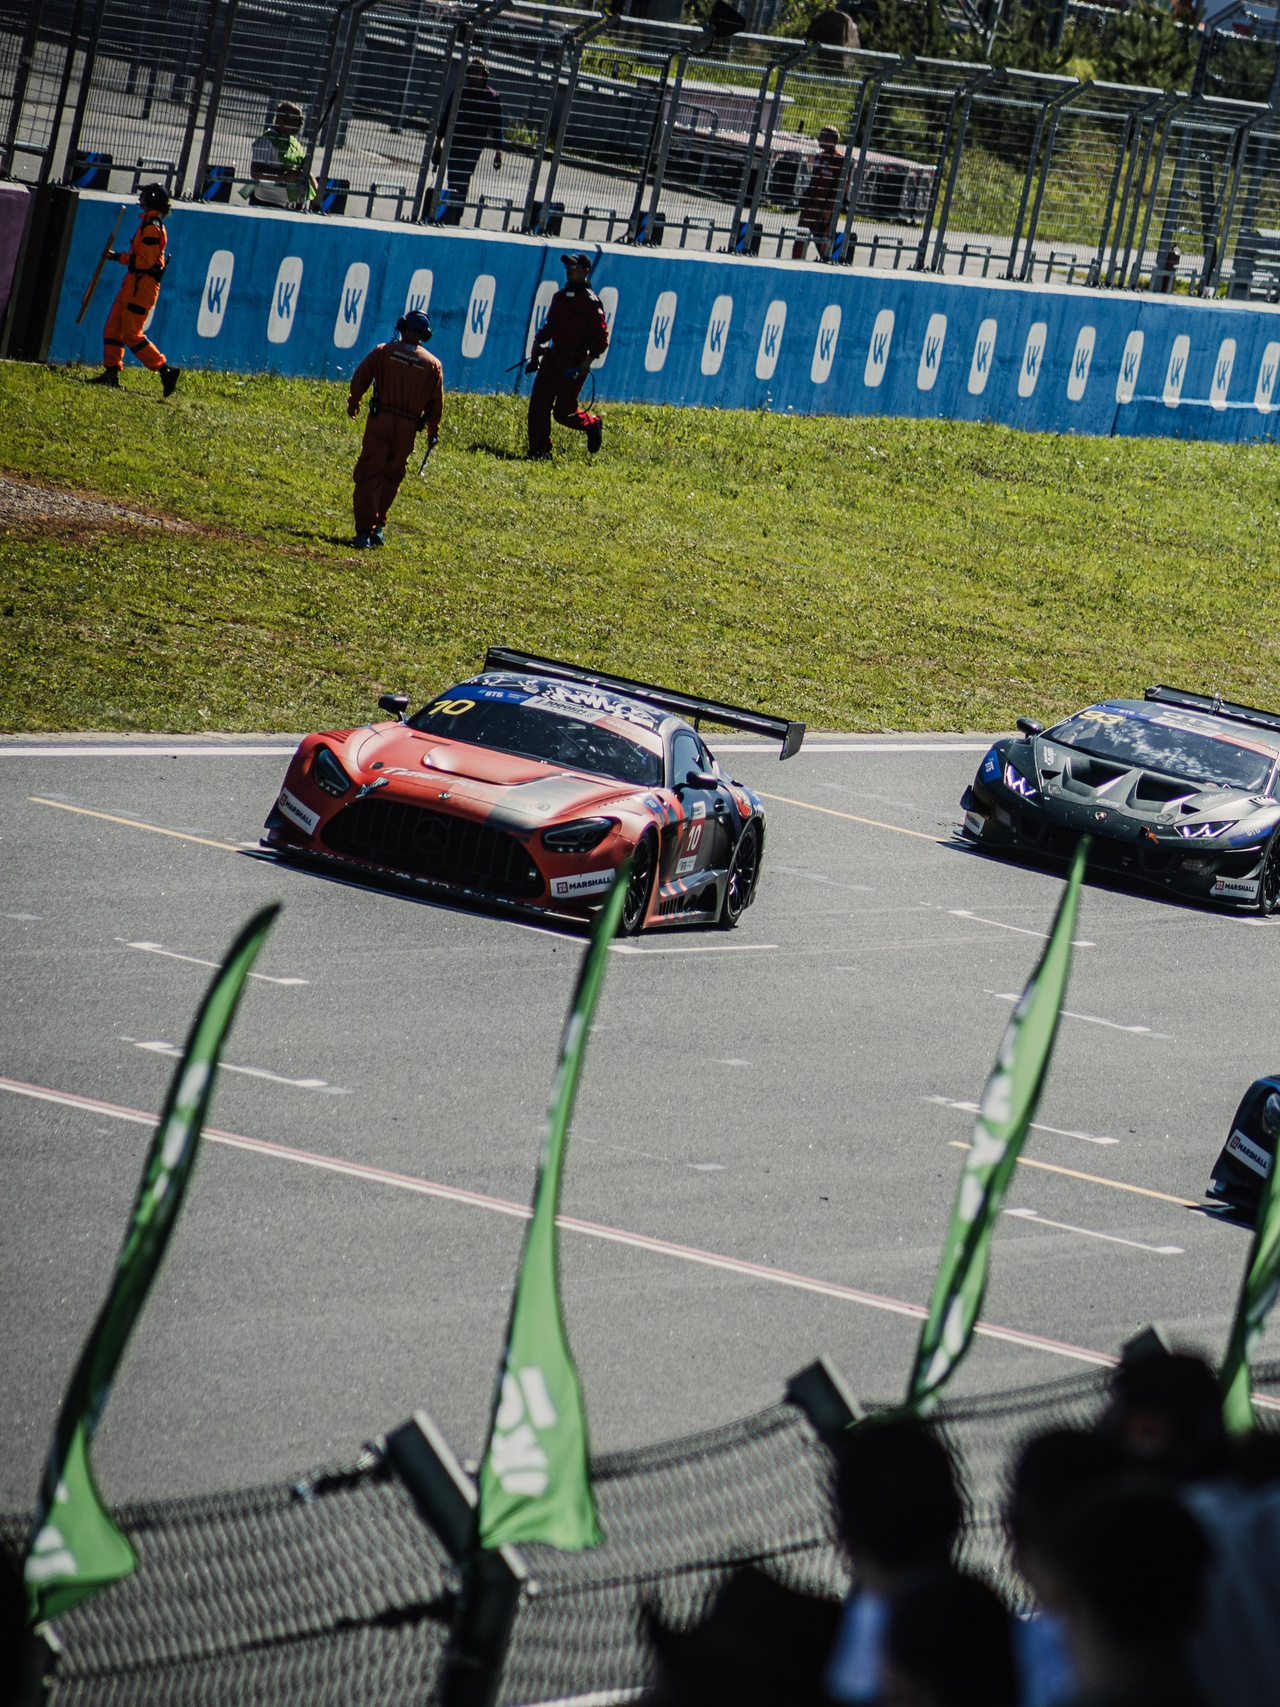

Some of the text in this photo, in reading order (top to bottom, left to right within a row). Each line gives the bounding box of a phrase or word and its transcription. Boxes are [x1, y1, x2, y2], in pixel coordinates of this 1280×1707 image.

[428, 699, 476, 716] 10
[1079, 710, 1125, 724] 93
[285, 800, 312, 827] MARSHALL
[687, 824, 702, 852] 10
[569, 874, 612, 890] MARSHALL
[1225, 883, 1254, 893] MARSHALL
[1238, 1144, 1268, 1169] MARSHALL
